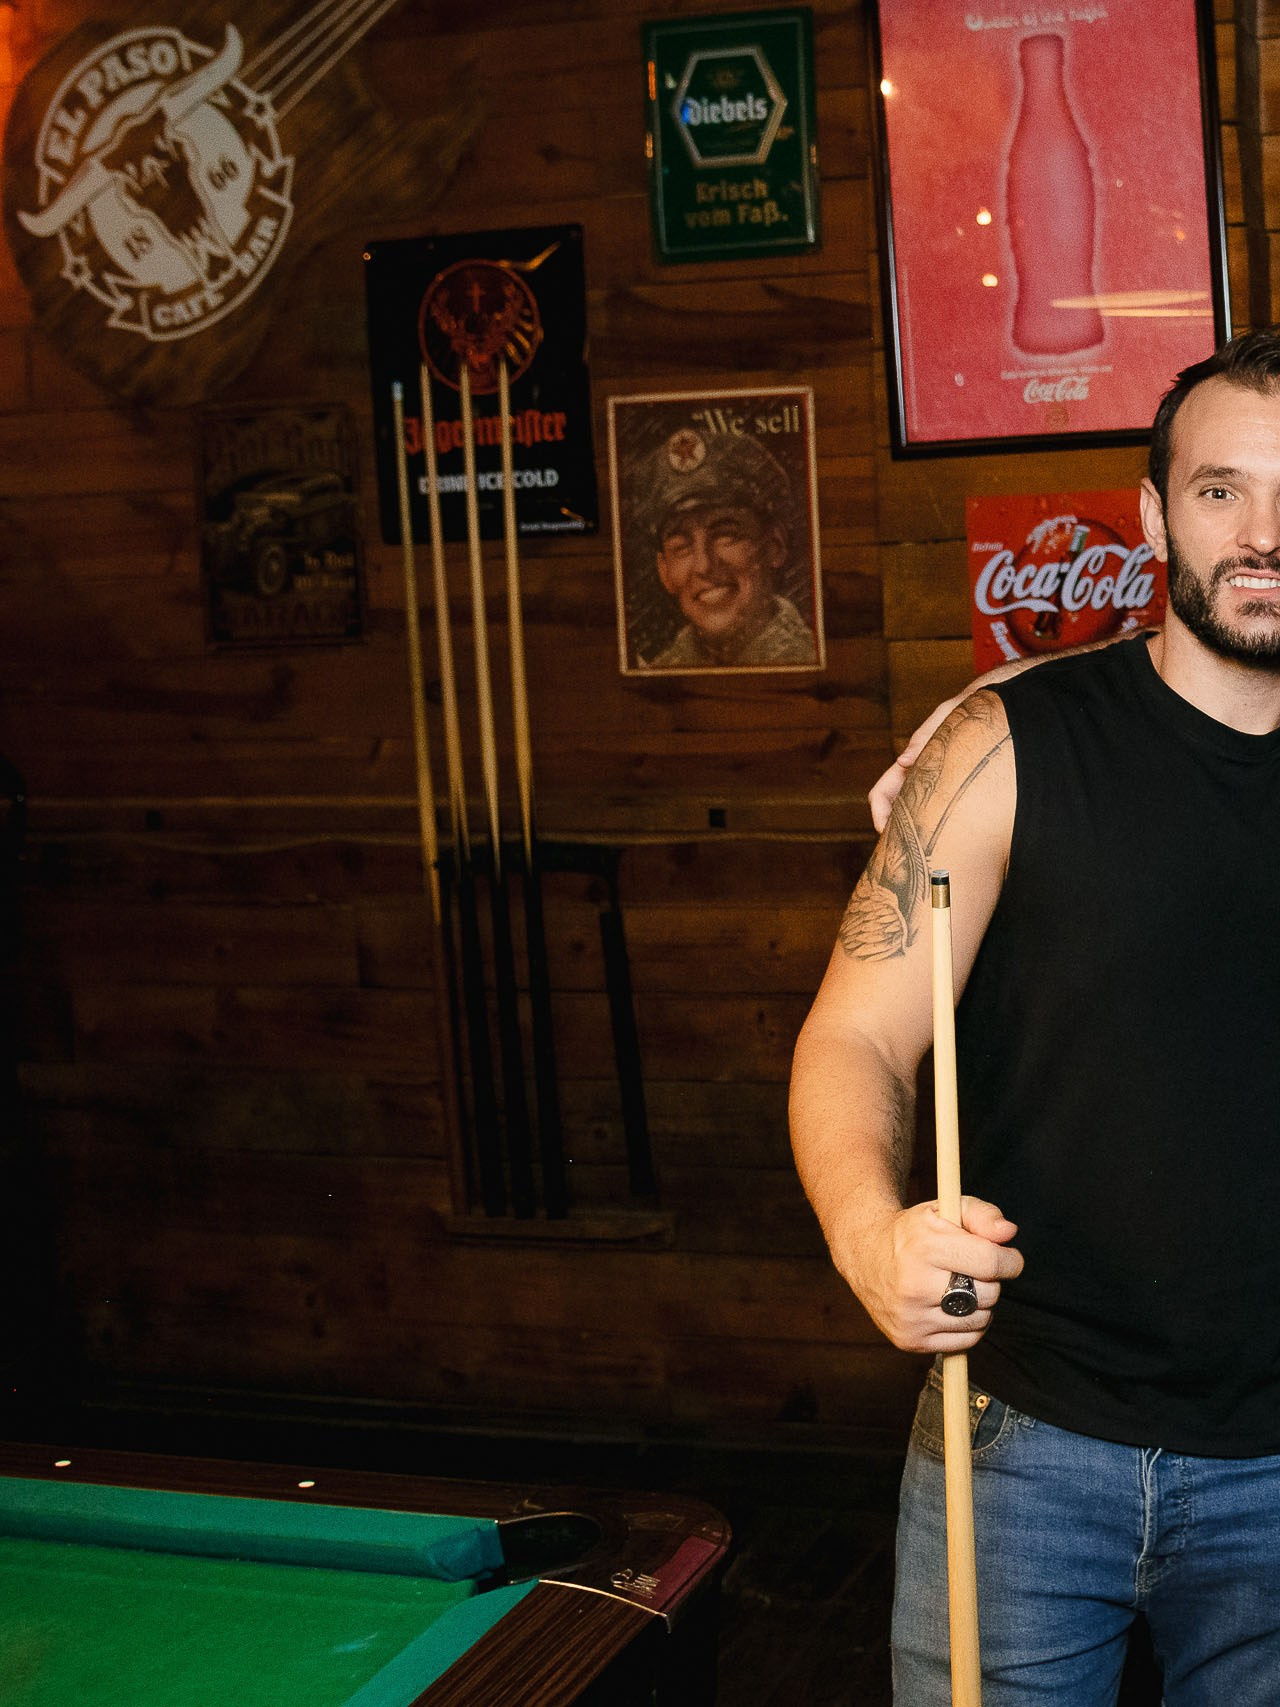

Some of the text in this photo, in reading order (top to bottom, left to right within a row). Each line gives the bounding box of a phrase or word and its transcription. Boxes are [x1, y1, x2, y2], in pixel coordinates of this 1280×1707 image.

[47, 40, 178, 166] EL PASO
[682, 93, 768, 126] Diebels
[240, 217, 279, 277] BAR
[404, 409, 567, 455] Jgemister
[755, 405, 800, 434] sell
[513, 469, 559, 488] COLD
[974, 543, 1156, 616] Coca-Cola
